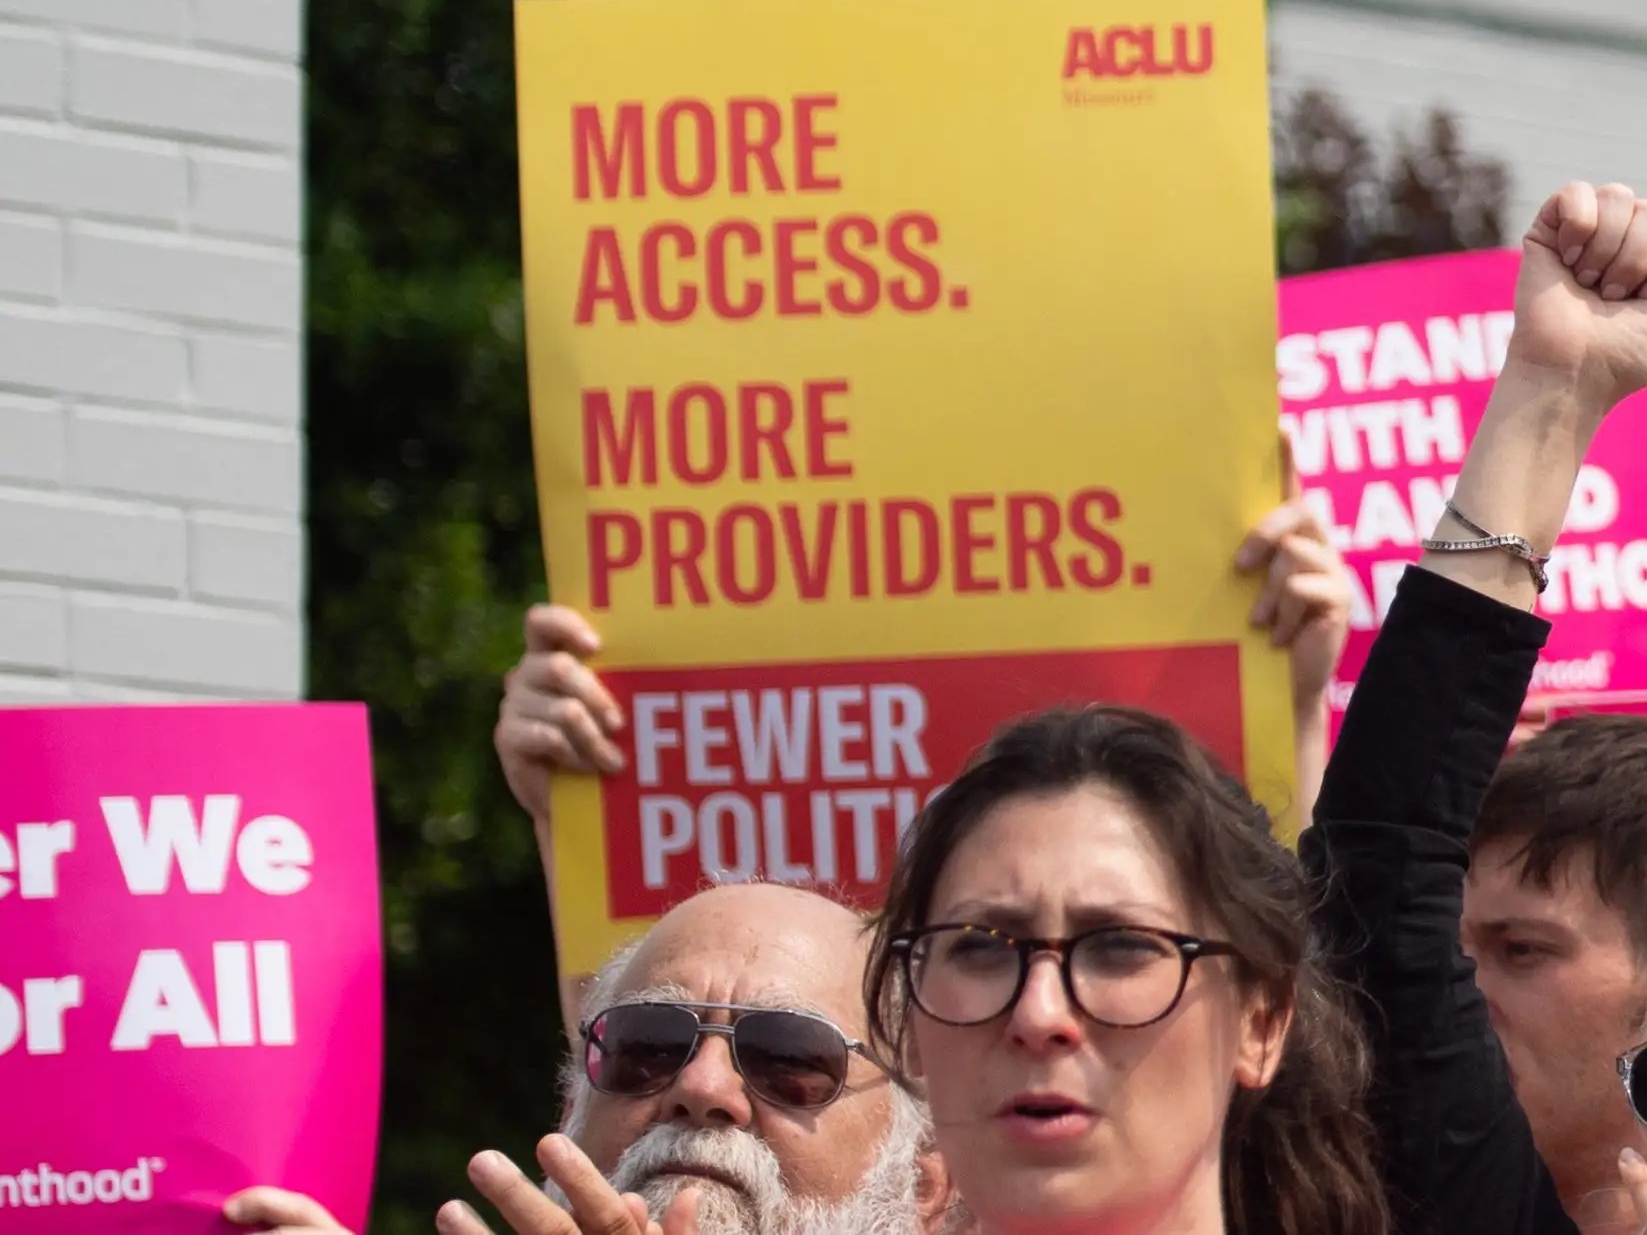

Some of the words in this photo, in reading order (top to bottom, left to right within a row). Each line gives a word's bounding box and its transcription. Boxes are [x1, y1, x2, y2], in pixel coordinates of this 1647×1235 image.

[1062, 22, 1214, 79] ACLU
[570, 93, 842, 202] MORE
[574, 212, 970, 325] ACCESS.
[580, 378, 854, 488] MORE
[586, 487, 1152, 611] PROVIDERS.
[633, 682, 931, 786] FEWER
[99, 794, 314, 896] We
[638, 785, 945, 889] POLITI
[110, 940, 297, 1052] All
